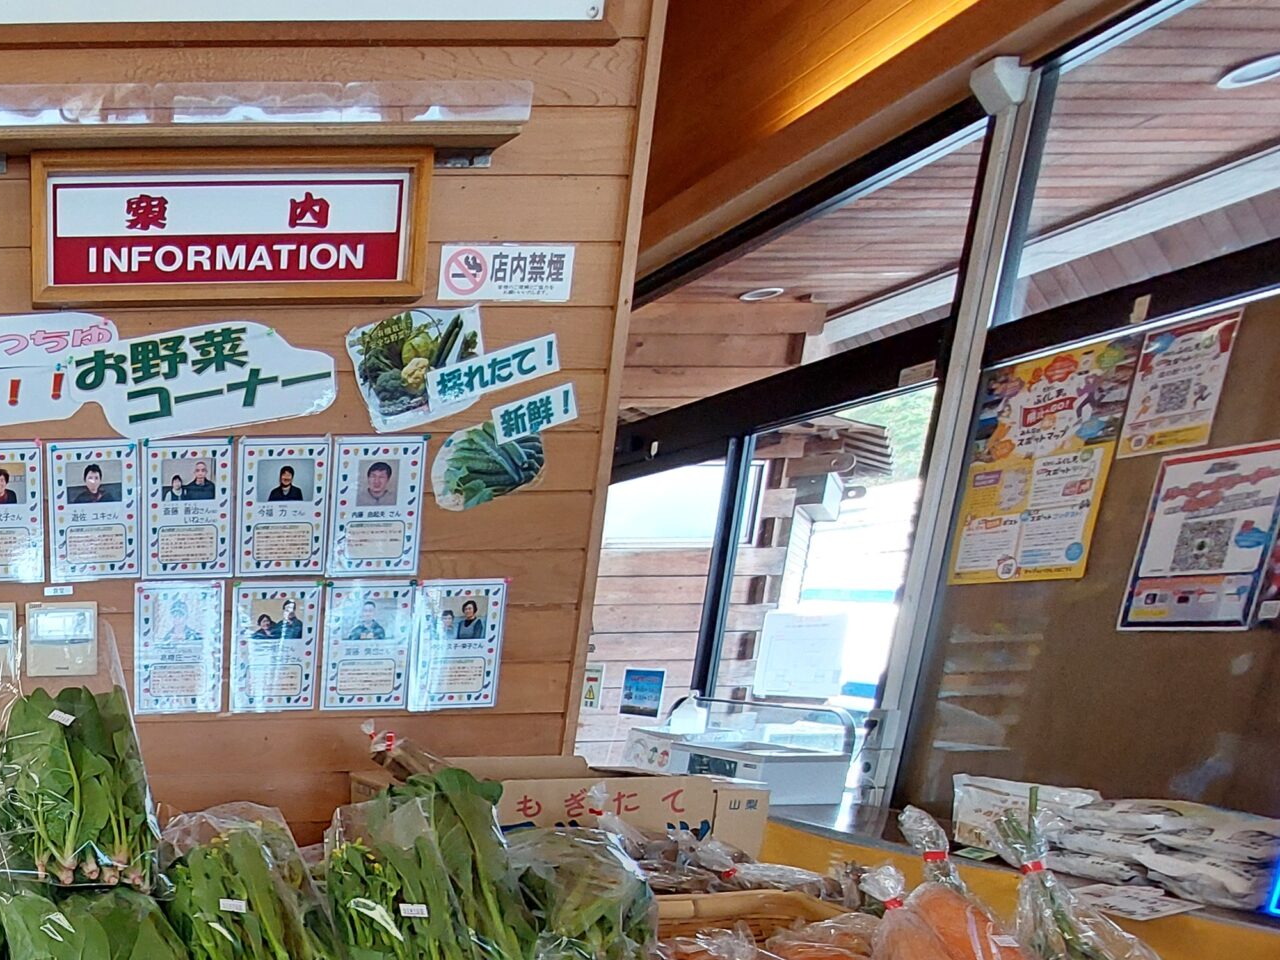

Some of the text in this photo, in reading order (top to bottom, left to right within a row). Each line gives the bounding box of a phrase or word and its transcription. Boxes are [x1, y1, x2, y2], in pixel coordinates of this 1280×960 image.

[87, 243, 366, 275] INFORMATION
[490, 252, 566, 283] 店内禁煙
[75, 326, 249, 391] お野菜
[127, 367, 333, 424] コーナー
[500, 389, 570, 438] 新鮮！
[516, 787, 686, 819] もぎたて
[728, 799, 759, 811] 山梨
